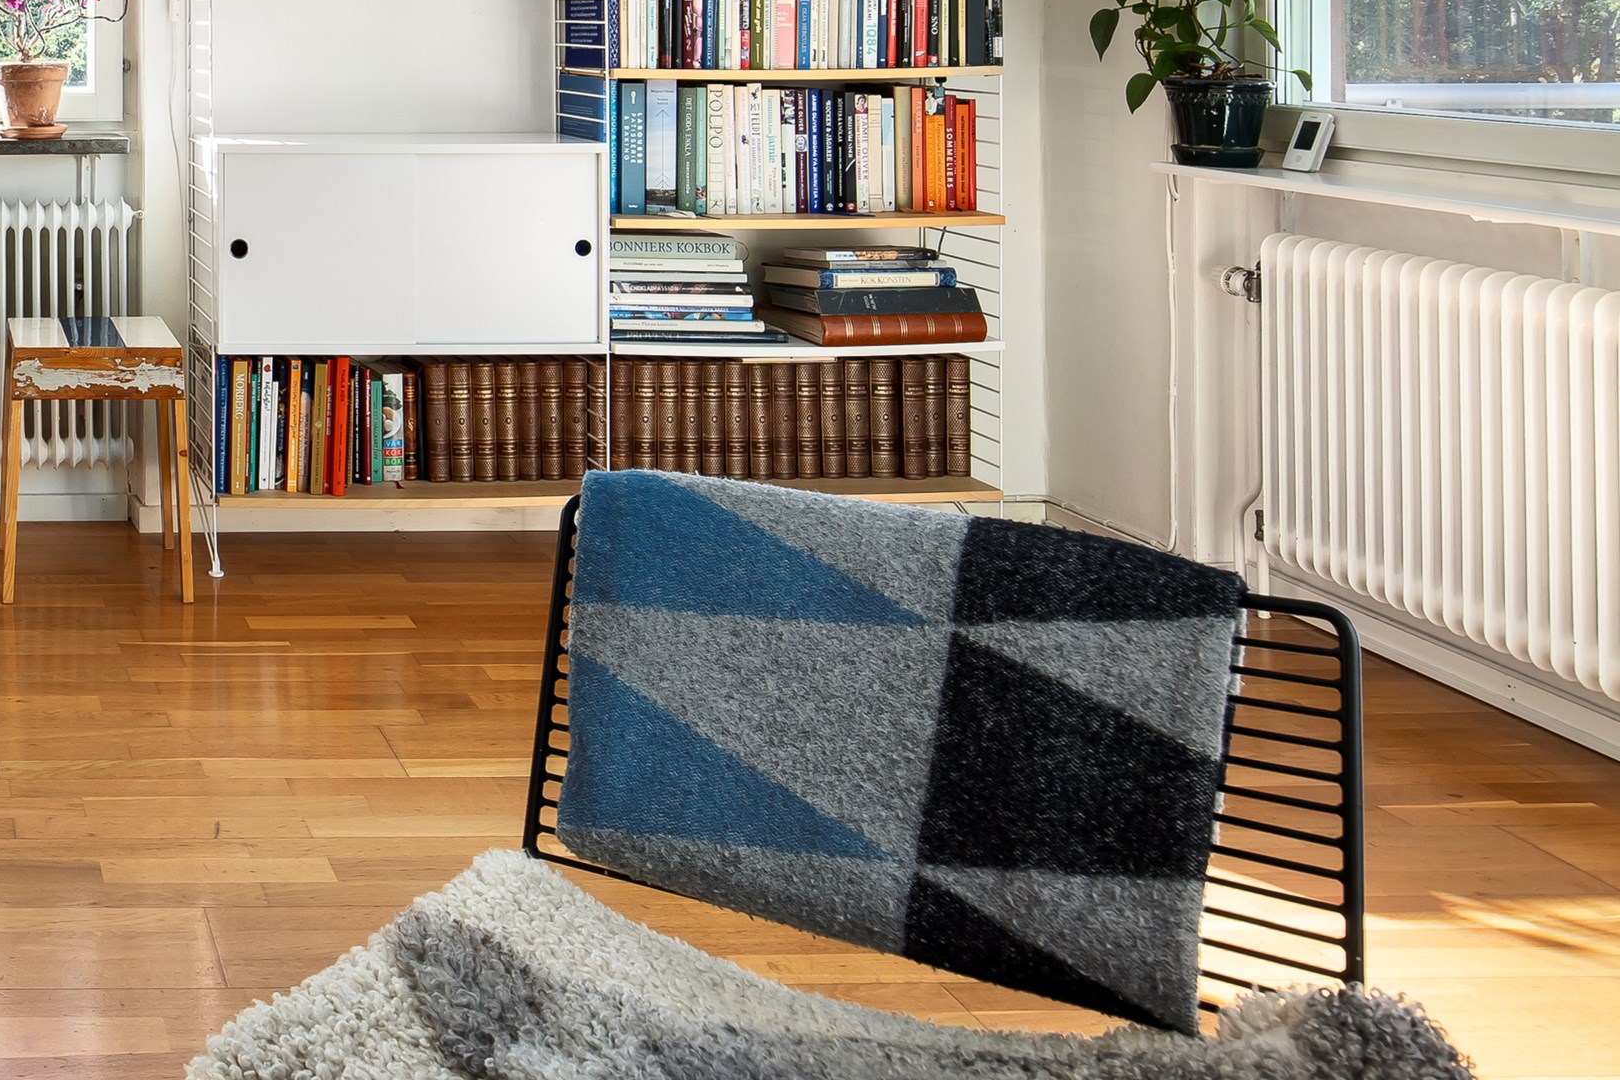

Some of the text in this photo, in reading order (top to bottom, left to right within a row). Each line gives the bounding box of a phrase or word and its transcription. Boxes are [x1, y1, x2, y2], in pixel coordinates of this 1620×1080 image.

[866, 22, 877, 55] 1Q84
[709, 90, 724, 149] POLPO
[750, 103, 760, 111] MY
[751, 112, 761, 136] FELDT
[684, 134, 692, 156] ENKLA
[766, 134, 777, 163] jamie
[825, 133, 833, 163] JÄGAREN
[946, 127, 954, 188] SOMMELIERS
[676, 242, 730, 254] KOKBOK
[626, 331, 680, 340] PROVENCE
[235, 372, 245, 420] MORBERG
[385, 449, 402, 457] KOK
